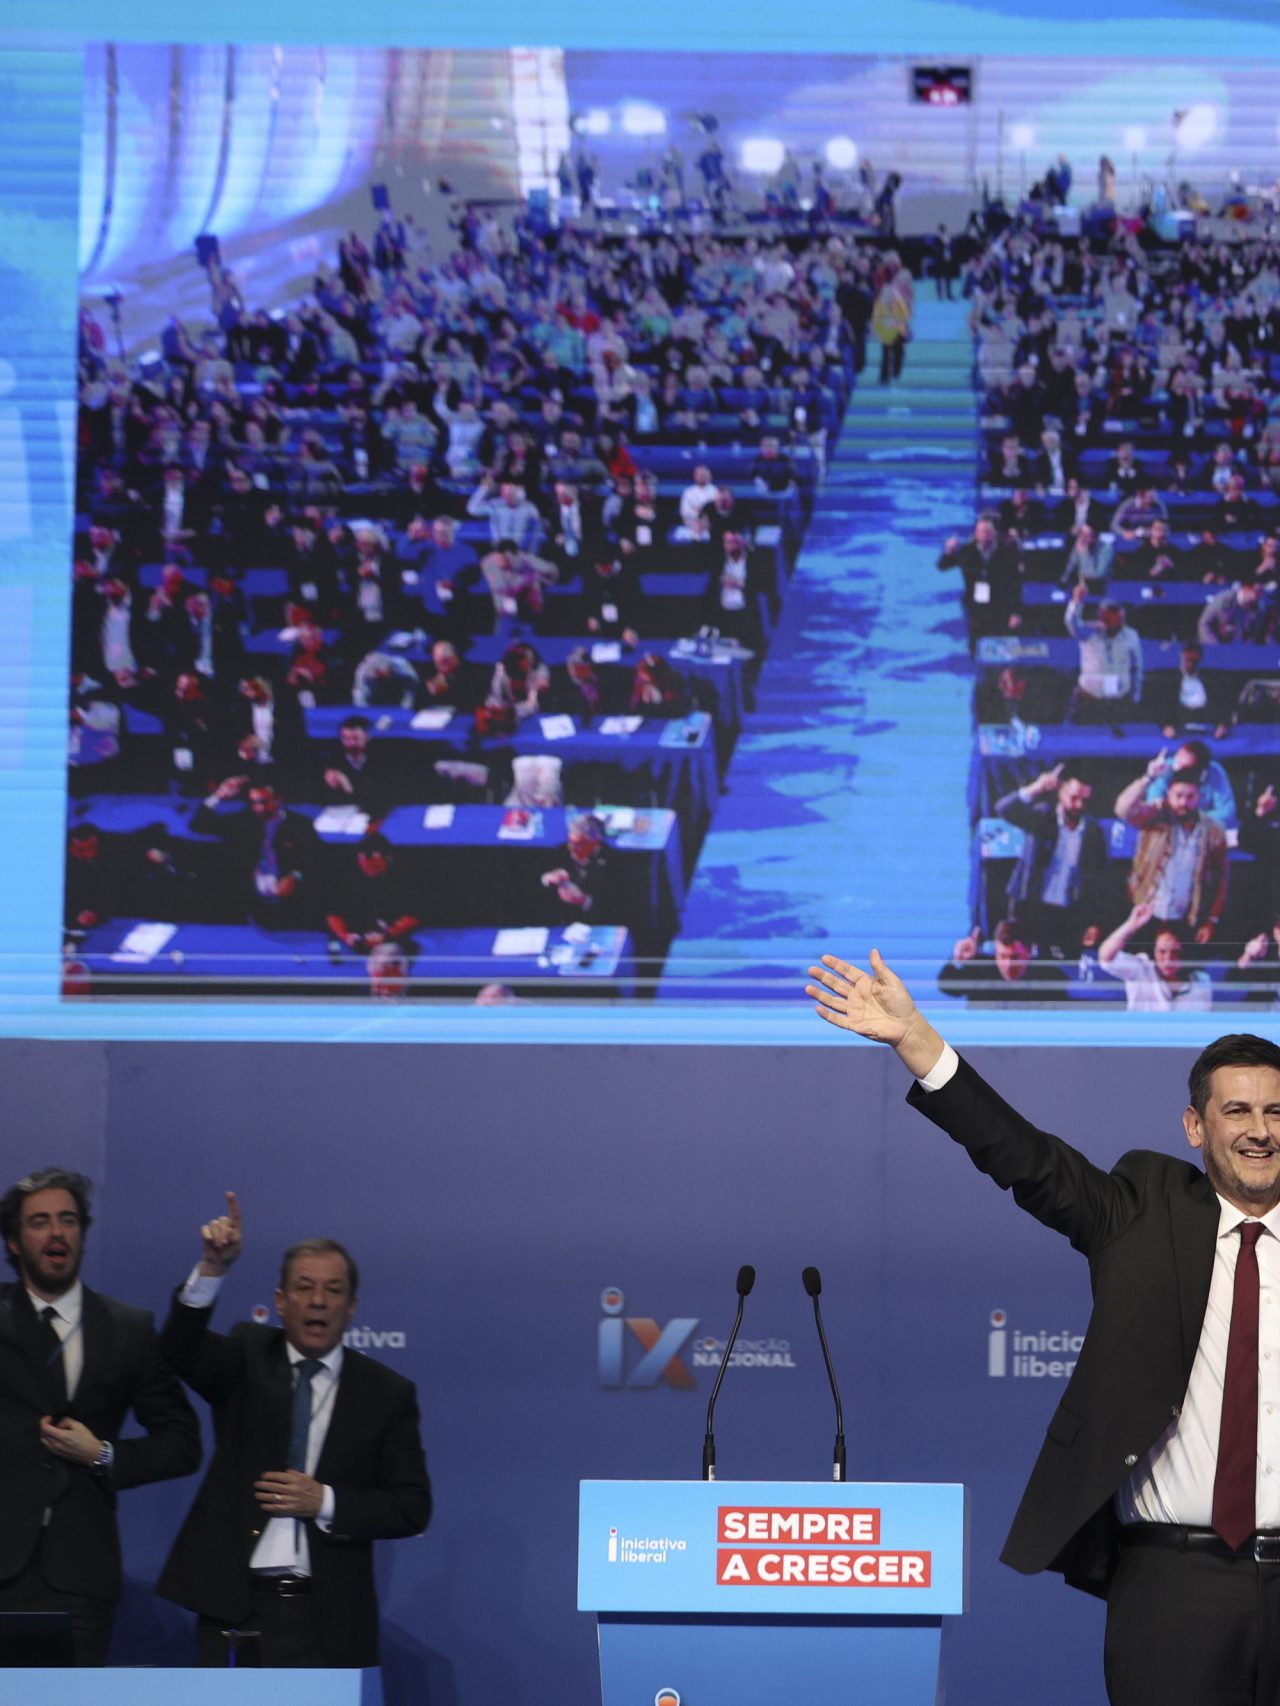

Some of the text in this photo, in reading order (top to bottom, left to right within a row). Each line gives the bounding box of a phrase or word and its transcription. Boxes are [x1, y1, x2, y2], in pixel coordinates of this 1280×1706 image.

[1013, 1330, 1085, 1353] inicia
[1013, 1354, 1077, 1378] liber
[723, 1511, 874, 1542] SEMPRE
[621, 1537, 687, 1551] iniciativa
[620, 1549, 667, 1563] liberal
[721, 1552, 926, 1584] A CRESCER
